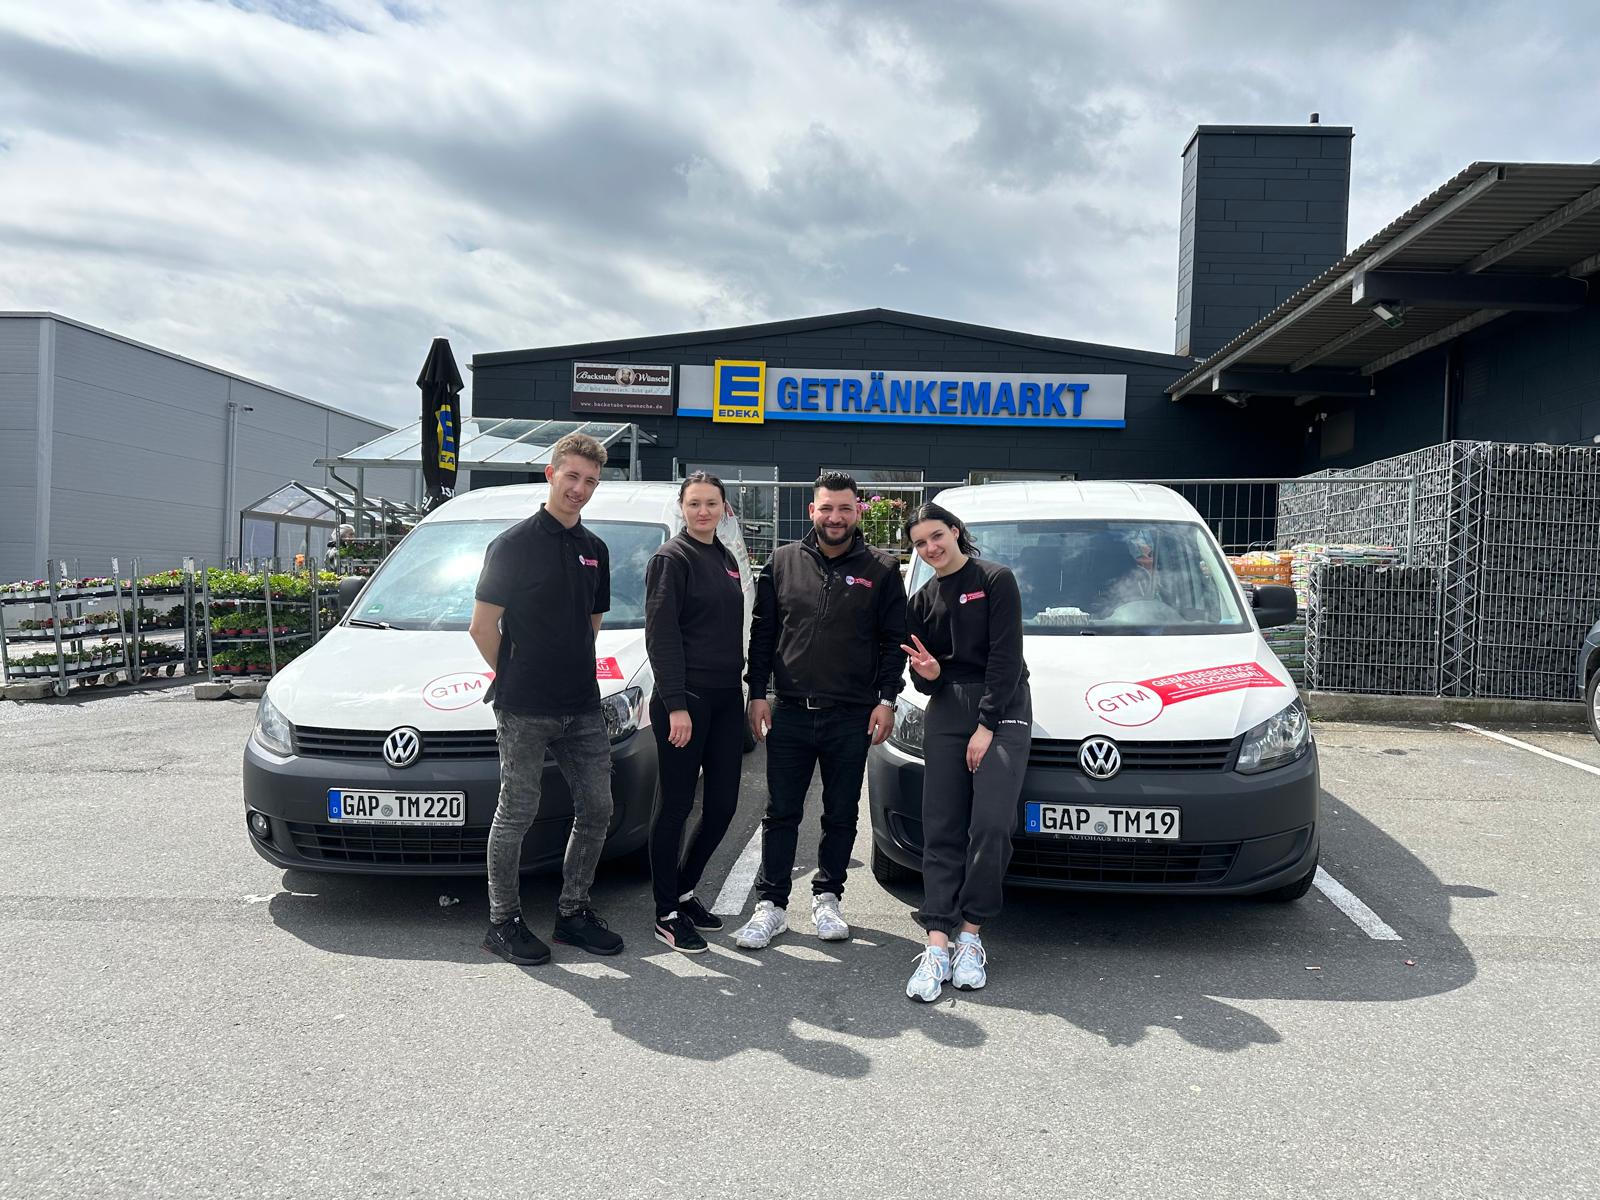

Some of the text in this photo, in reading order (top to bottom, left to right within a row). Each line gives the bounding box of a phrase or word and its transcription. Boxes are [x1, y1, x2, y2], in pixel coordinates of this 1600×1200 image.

[576, 371, 616, 381] Backstube
[719, 366, 760, 406] E
[776, 371, 1091, 417] GETRÄNKEMARKT
[718, 409, 760, 418] EDEKA
[1151, 664, 1257, 687] GEBÄUDESERVICE
[1185, 671, 1264, 687] TROCKENBAU
[431, 679, 482, 698] GTM
[1097, 689, 1150, 712] GTM
[343, 795, 380, 817] GAP
[1042, 807, 1090, 831] GAP
[1069, 834, 1112, 842] AUTOHAUS
